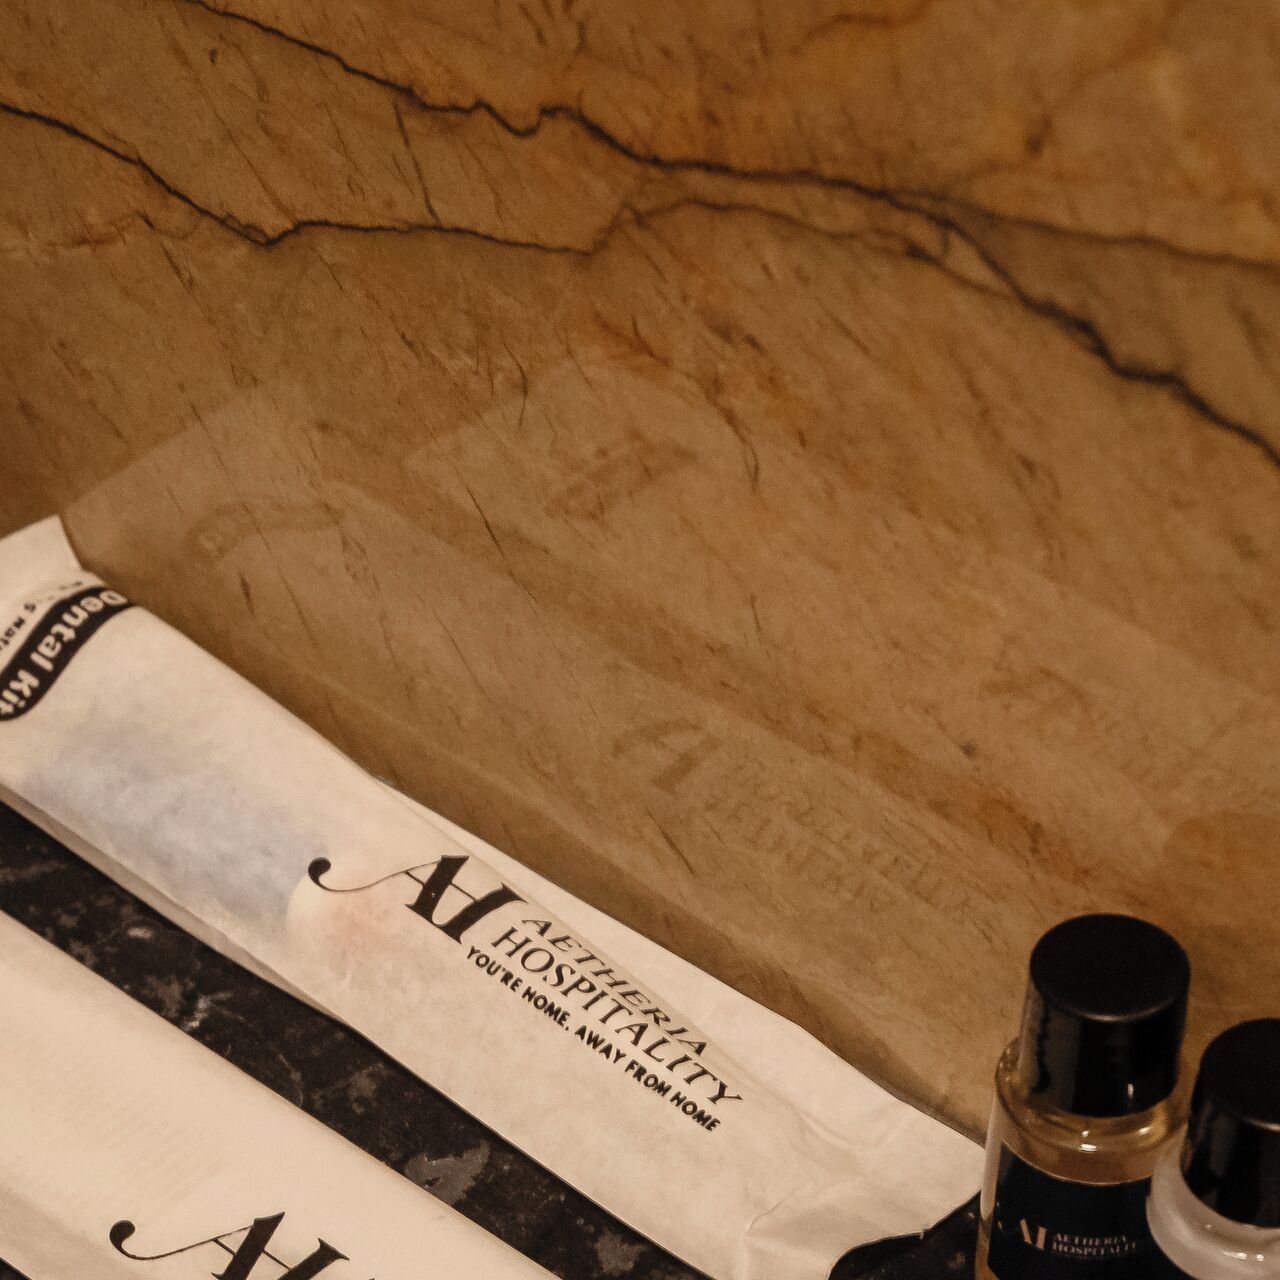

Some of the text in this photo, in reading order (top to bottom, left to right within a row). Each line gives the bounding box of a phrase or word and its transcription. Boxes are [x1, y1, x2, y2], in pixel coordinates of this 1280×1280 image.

[30, 590, 128, 672] Dental
[466, 945, 522, 992] YOU'RE
[575, 1025, 627, 1063] AWAY
[624, 1060, 672, 1097] FROM
[670, 1093, 722, 1133] HOME
[491, 926, 744, 1106] HOSPITALITY
[522, 916, 708, 1056] AETHERIA
